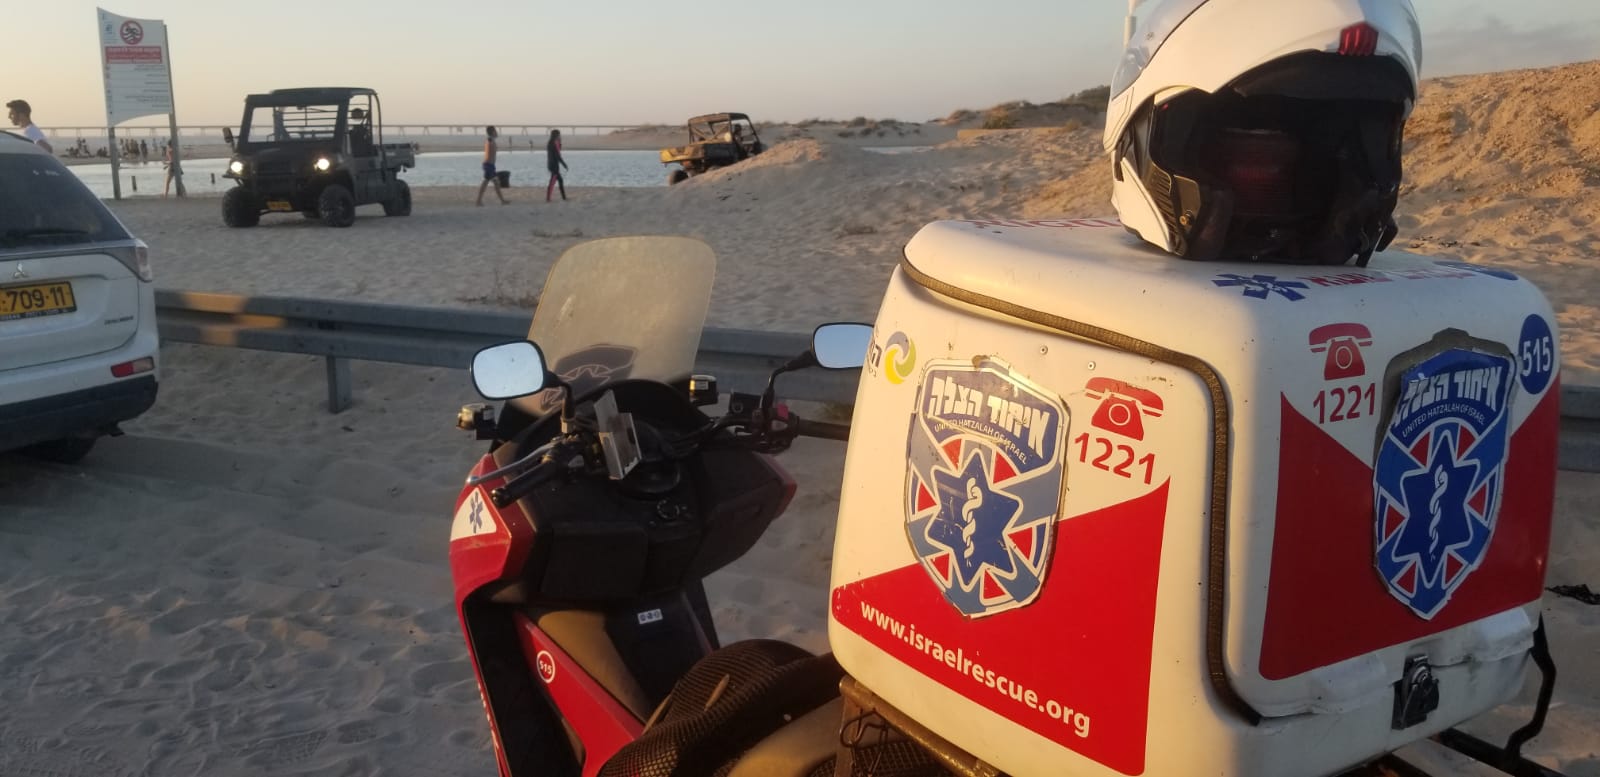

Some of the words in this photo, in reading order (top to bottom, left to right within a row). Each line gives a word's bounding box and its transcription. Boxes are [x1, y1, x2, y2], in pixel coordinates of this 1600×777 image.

[1522, 336, 1551, 377] 515
[930, 376, 984, 418] הצלה
[1313, 382, 1376, 425] 1221
[1393, 371, 1451, 428] הצלה
[1454, 365, 1503, 412] איחוד
[958, 417, 994, 437] HATZALAH
[987, 395, 1050, 459] איחוד
[1402, 413, 1427, 438] UNITED
[1427, 402, 1461, 418] HATZALAH
[1467, 406, 1486, 427] ISRAEL
[1074, 432, 1155, 485] 1221
[539, 660, 552, 676] 515
[860, 600, 1091, 738] www.israelrescue.org
